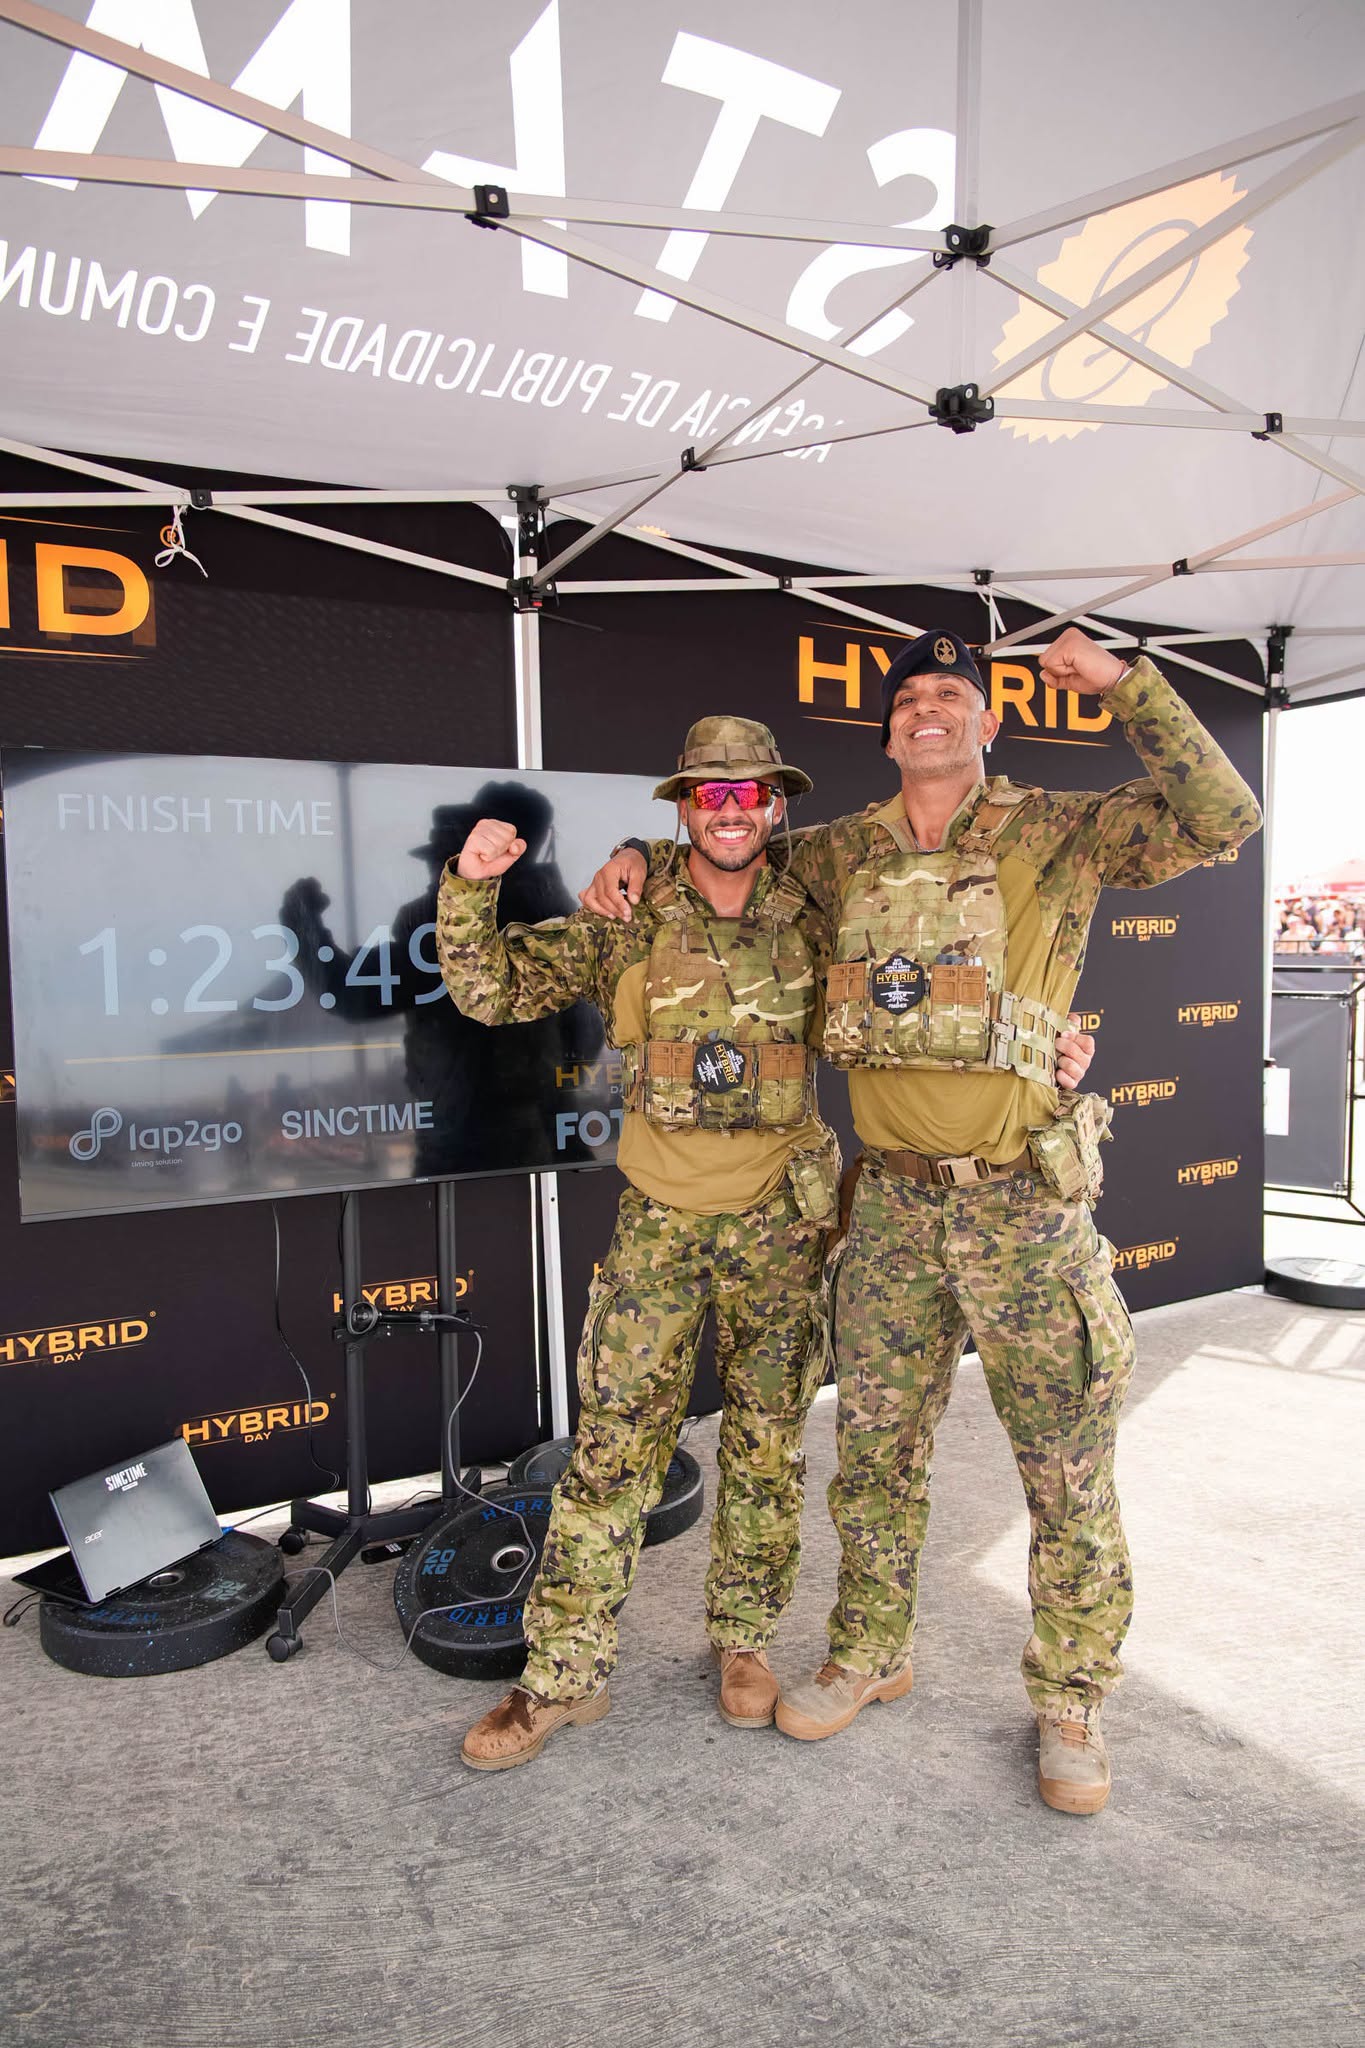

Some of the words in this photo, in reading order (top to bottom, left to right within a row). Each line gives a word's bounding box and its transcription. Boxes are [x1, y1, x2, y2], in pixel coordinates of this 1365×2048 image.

[799, 636, 1113, 732] HRID
[57, 793, 212, 833] FINISH
[225, 798, 334, 836] TIME
[1112, 919, 1177, 936] HYBRID
[876, 973, 918, 982] HYBRID
[1178, 1004, 1238, 1023] HYBRID
[715, 1044, 735, 1083] HYBRID
[1111, 1081, 1177, 1103] HYBRID
[281, 1101, 435, 1140] SINCTIME
[129, 1120, 243, 1154] lap2go
[131, 1160, 155, 1168] timing
[155, 1157, 183, 1166] solution
[1178, 1160, 1239, 1184] HYBRID
[1202, 1178, 1215, 1186] DAY
[1112, 1242, 1177, 1269] HYBRID
[1138, 1262, 1151, 1270] DAY
[53, 1351, 84, 1364] DAY
[182, 1401, 330, 1444] HYBRID
[244, 1431, 272, 1443] DAY
[104, 1462, 149, 1491] SINCTIME
[84, 1529, 104, 1544] acer
[425, 1549, 457, 1564] 20
[421, 1563, 449, 1575] KG
